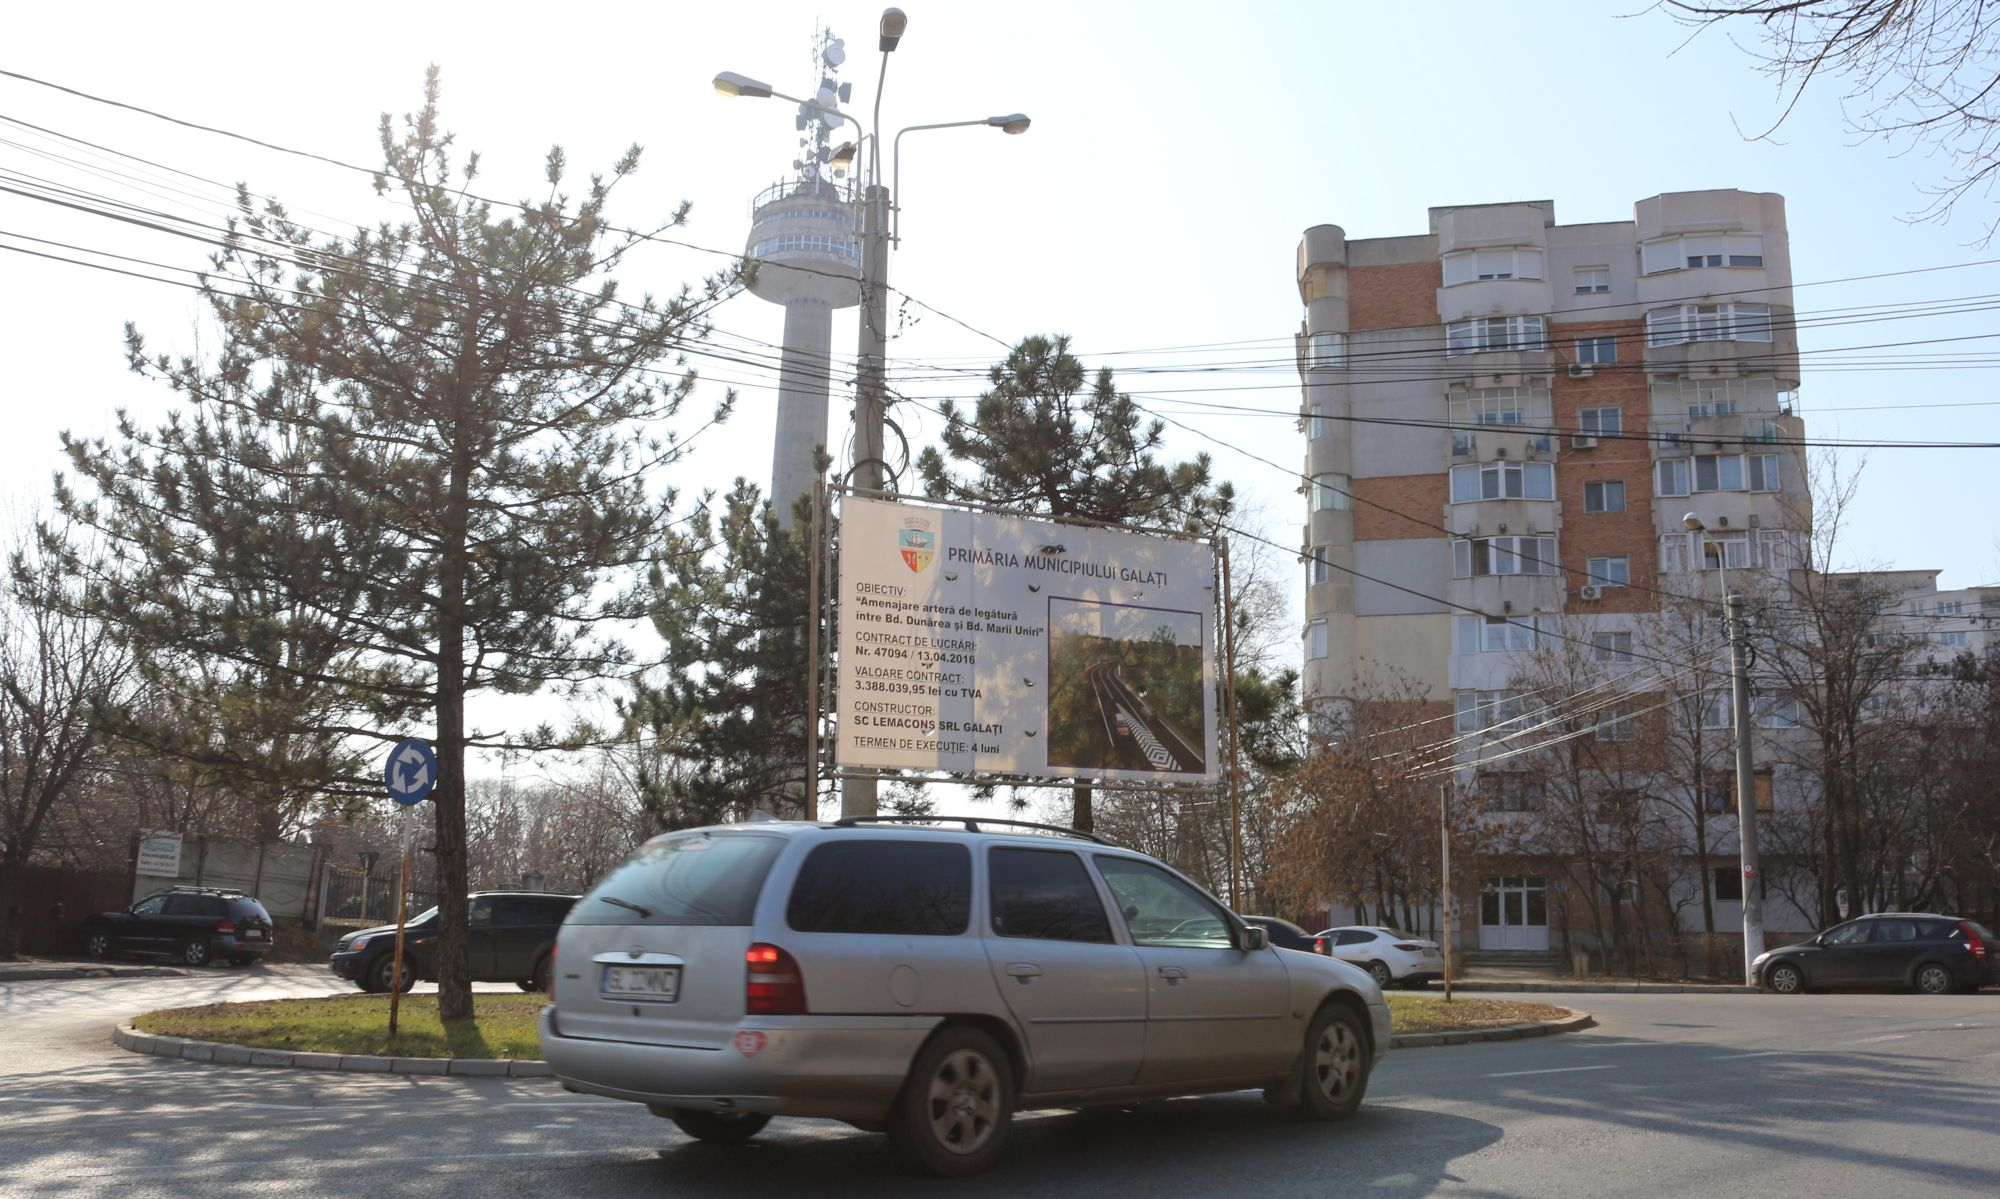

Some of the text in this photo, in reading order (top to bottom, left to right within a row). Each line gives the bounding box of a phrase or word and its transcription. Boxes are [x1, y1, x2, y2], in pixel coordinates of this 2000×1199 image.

[948, 547, 1168, 588] PRIMĂRIA MUNICIPIULUI GALAȚI
[856, 582, 906, 596] OBIECTIV:
[922, 604, 955, 615] arteră
[958, 606, 971, 616] de
[975, 607, 1018, 621] legătură
[855, 611, 881, 623] între
[885, 614, 902, 625] Bd.
[906, 616, 951, 629] Dunărea
[966, 621, 983, 632] Bd.
[986, 623, 1012, 634] Marii
[855, 631, 912, 646] CONTRACT
[914, 636, 928, 647] DE
[855, 646, 870, 656] Nr.
[874, 647, 907, 659] 47094
[917, 651, 976, 664] 13.04.2016
[855, 666, 965, 684] VALOARE CONTRACT:
[855, 680, 982, 699] 3.388.039,95 lei cu TVA
[854, 701, 935, 716] CONSTRUCTOR:
[854, 715, 1003, 736] SC LEMACONS SRL GALAȚI
[853, 736, 896, 748] TERMEN
[899, 739, 913, 749] DE
[971, 743, 978, 752] 4
[981, 743, 1000, 754] luni
